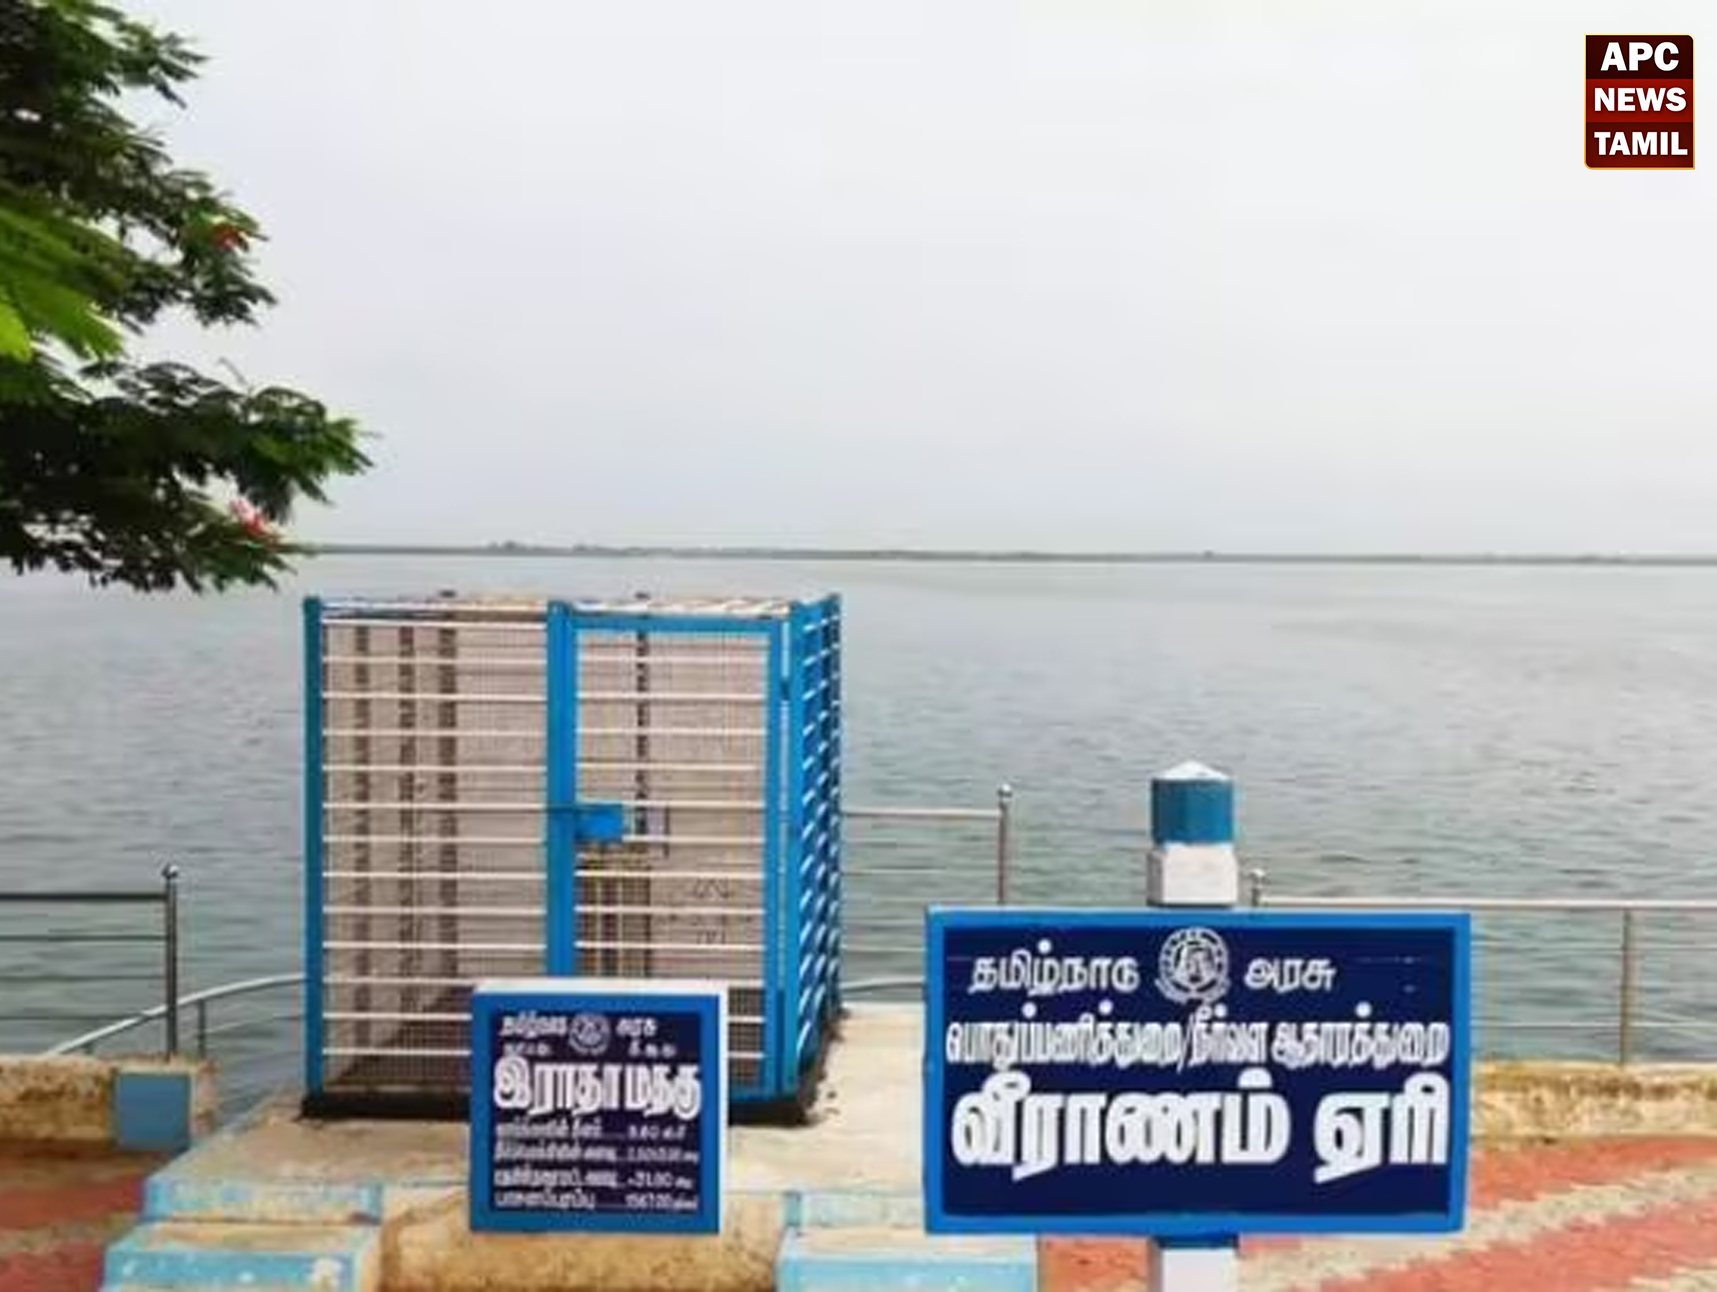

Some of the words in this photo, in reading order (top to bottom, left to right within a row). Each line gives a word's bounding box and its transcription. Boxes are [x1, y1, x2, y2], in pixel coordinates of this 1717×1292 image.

[967, 938, 1141, 996] தமிழ்நாடு
[1243, 957, 1337, 994] அரசு
[1271, 1001, 1450, 1070] ஆதாரத்துறை
[950, 1067, 1291, 1181] வீராணம்
[1313, 1071, 1451, 1184] ஏரி
